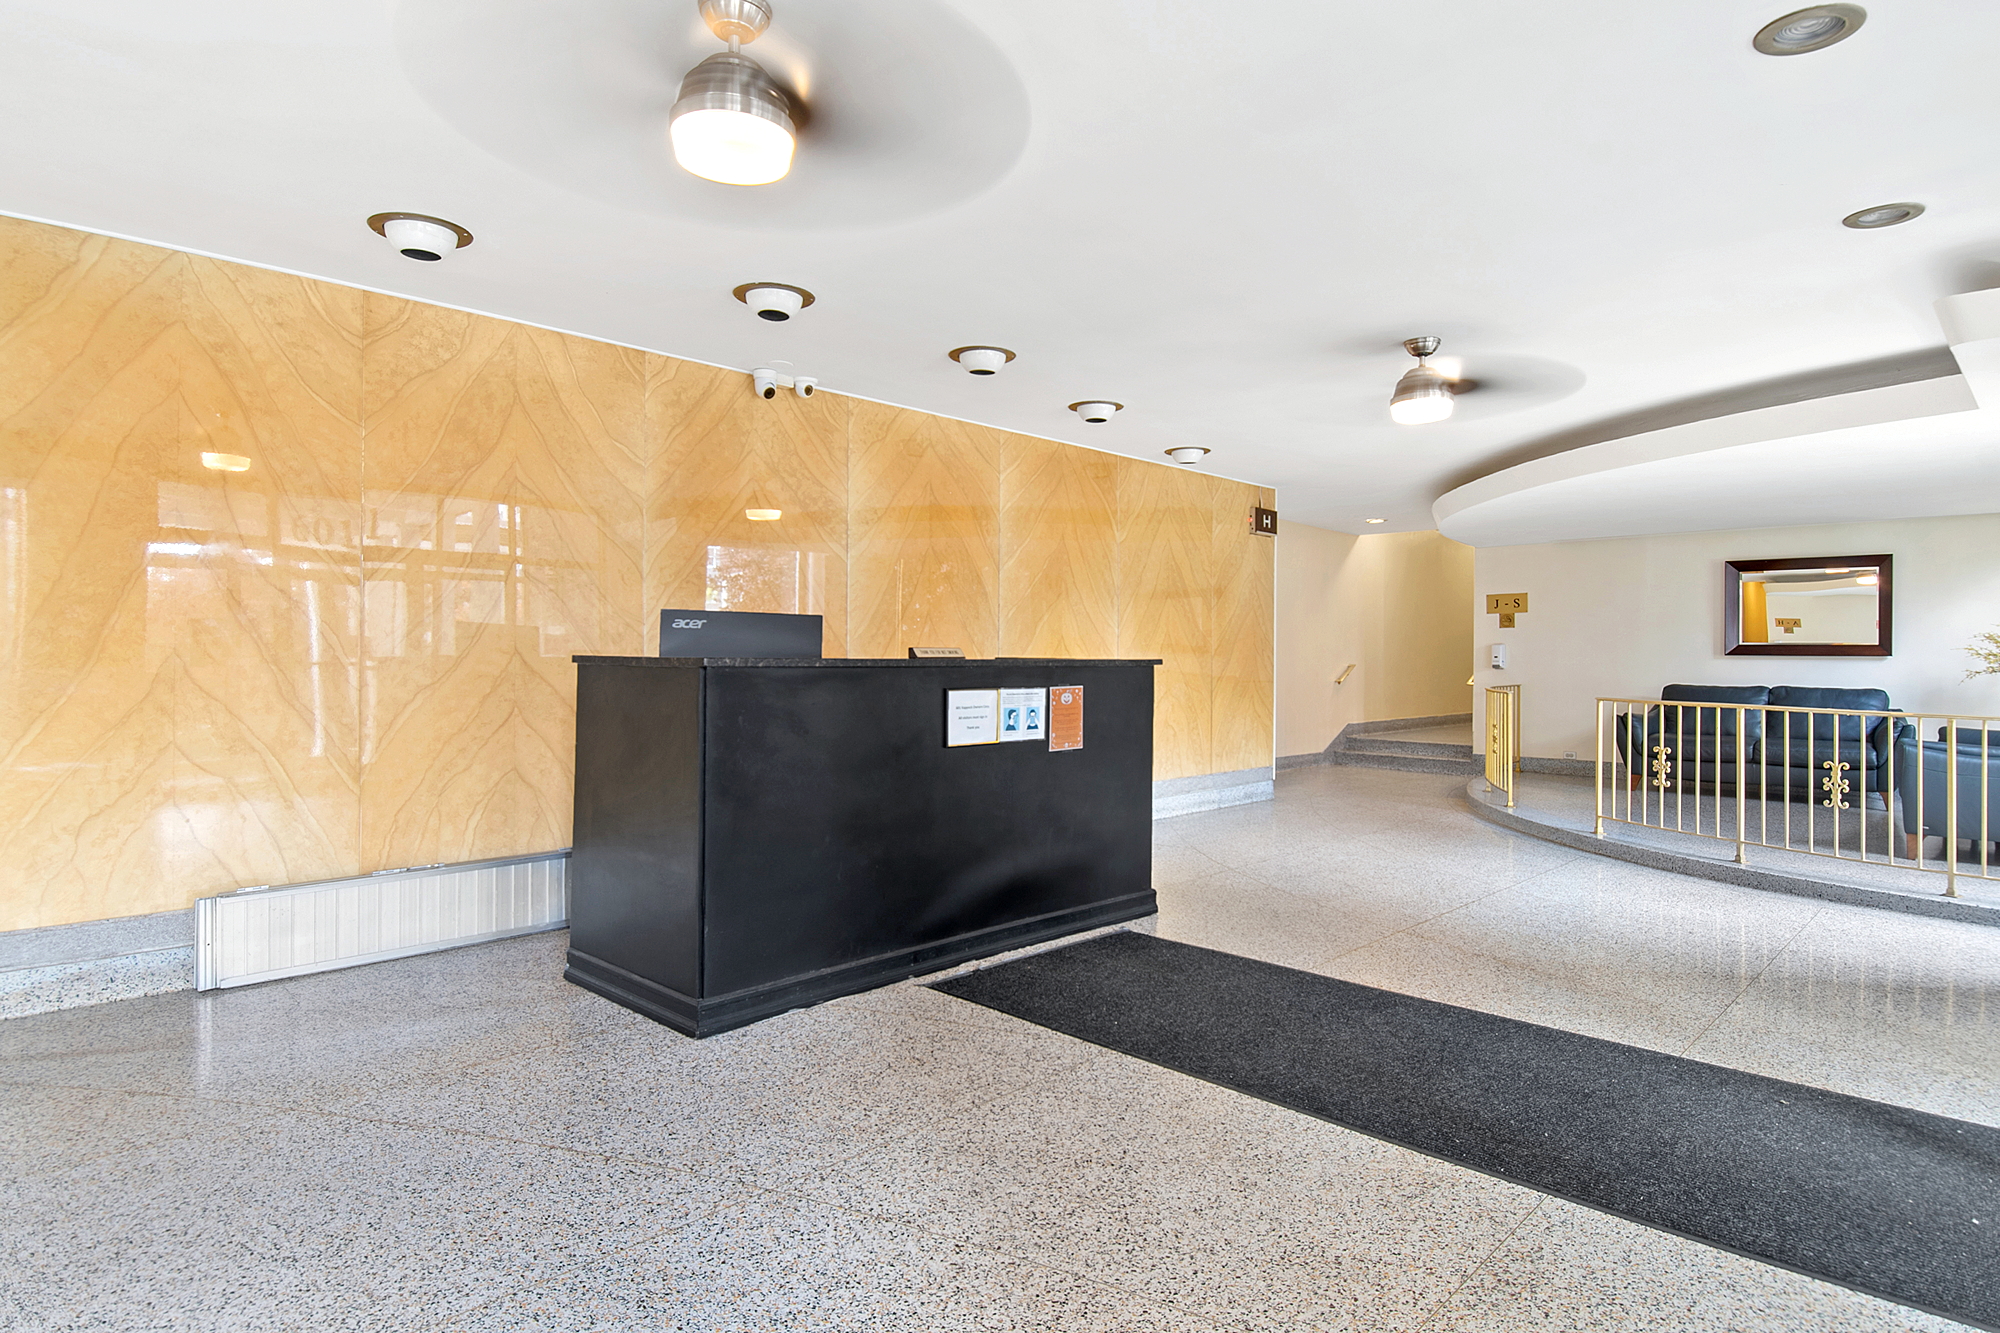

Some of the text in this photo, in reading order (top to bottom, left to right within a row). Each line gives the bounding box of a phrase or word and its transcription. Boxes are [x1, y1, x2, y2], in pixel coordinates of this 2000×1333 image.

[1262, 514, 1272, 529] H
[1494, 599, 1499, 609] J
[1513, 598, 1521, 608] S
[671, 618, 708, 629] acer
